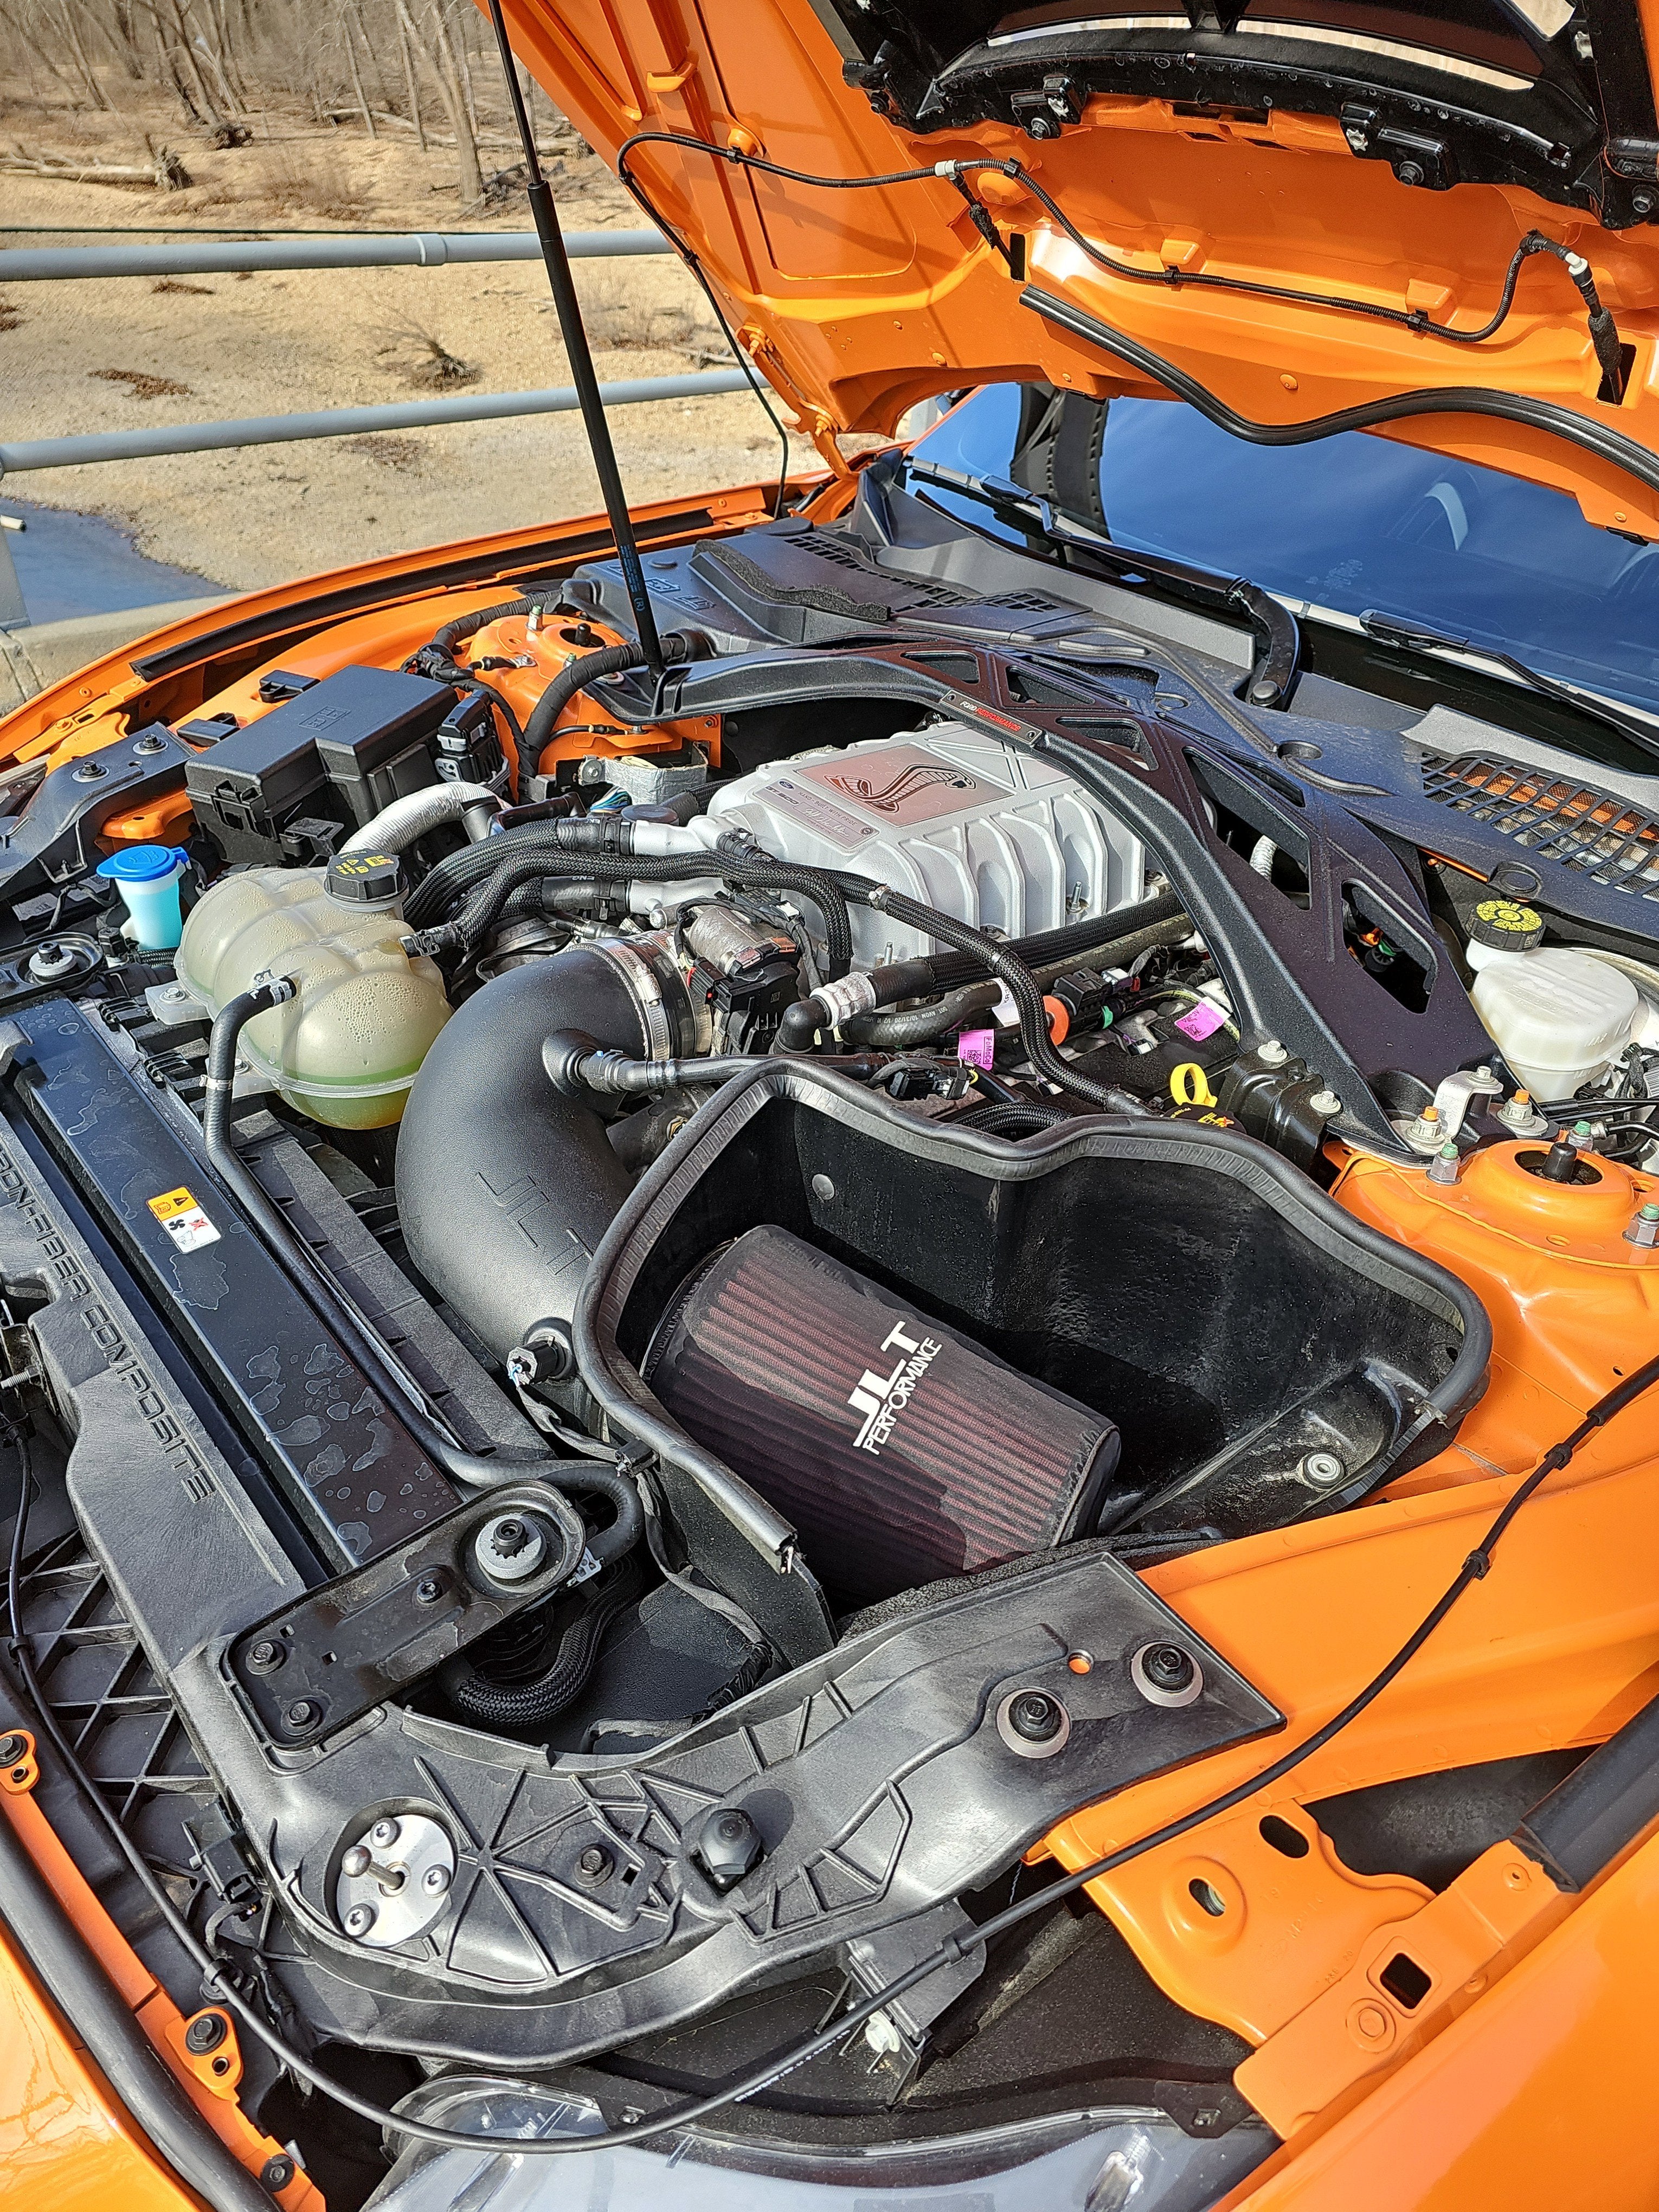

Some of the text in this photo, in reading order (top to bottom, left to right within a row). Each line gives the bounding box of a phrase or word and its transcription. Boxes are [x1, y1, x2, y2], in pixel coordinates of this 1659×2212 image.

[960, 701, 1022, 732] FORD PERFORMANCE
[828, 808, 841, 818] WITH
[841, 815, 857, 826] PRIDE
[895, 1014, 918, 1023] 10/31/20
[922, 1011, 936, 1019] AVON
[847, 1321, 920, 1446] JLT
[863, 1337, 942, 1455] PERFORMANCE
[80, 1304, 216, 1503] COMPOSITE
